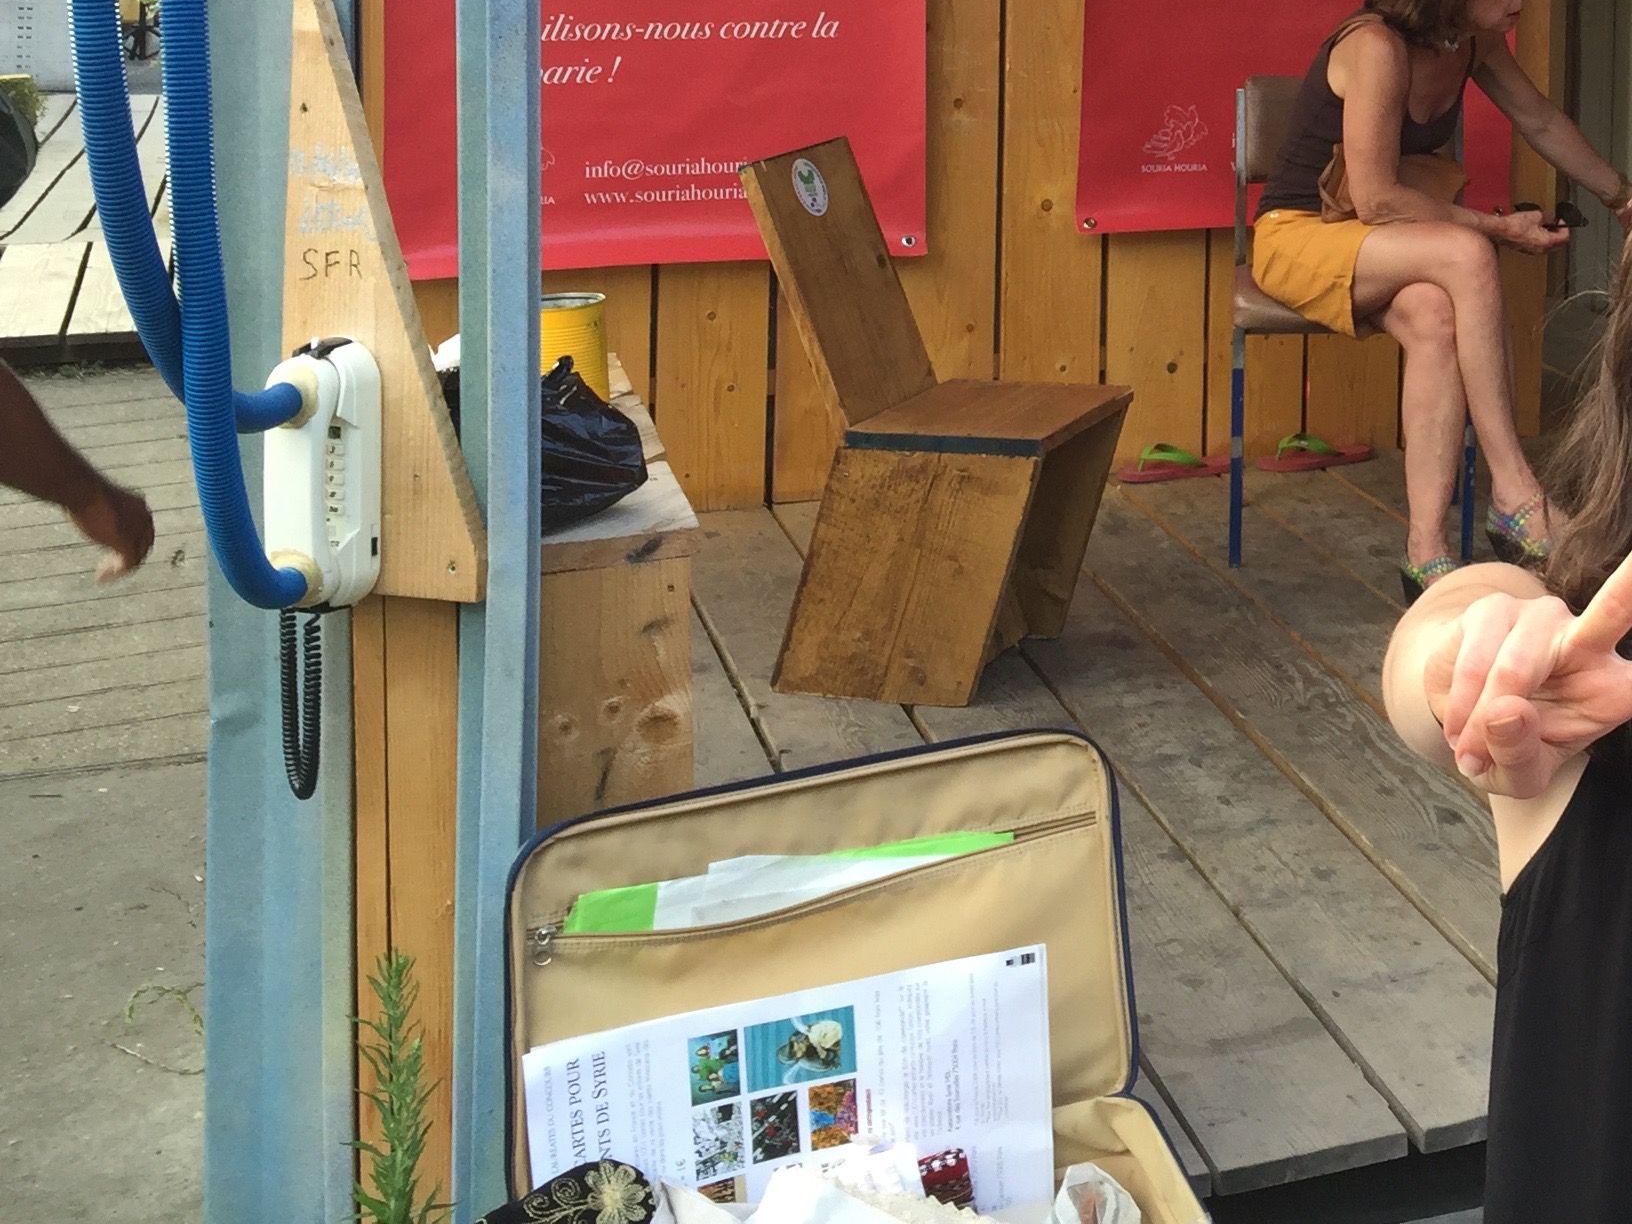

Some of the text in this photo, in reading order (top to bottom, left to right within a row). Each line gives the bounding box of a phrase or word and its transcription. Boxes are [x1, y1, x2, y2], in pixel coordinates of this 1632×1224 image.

[541, 11, 840, 40] ilisons-nous contre la
[540, 57, 603, 85] arie
[299, 247, 363, 281] SFR
[565, 1057, 582, 1104] POUR
[594, 1100, 610, 1123] DE
